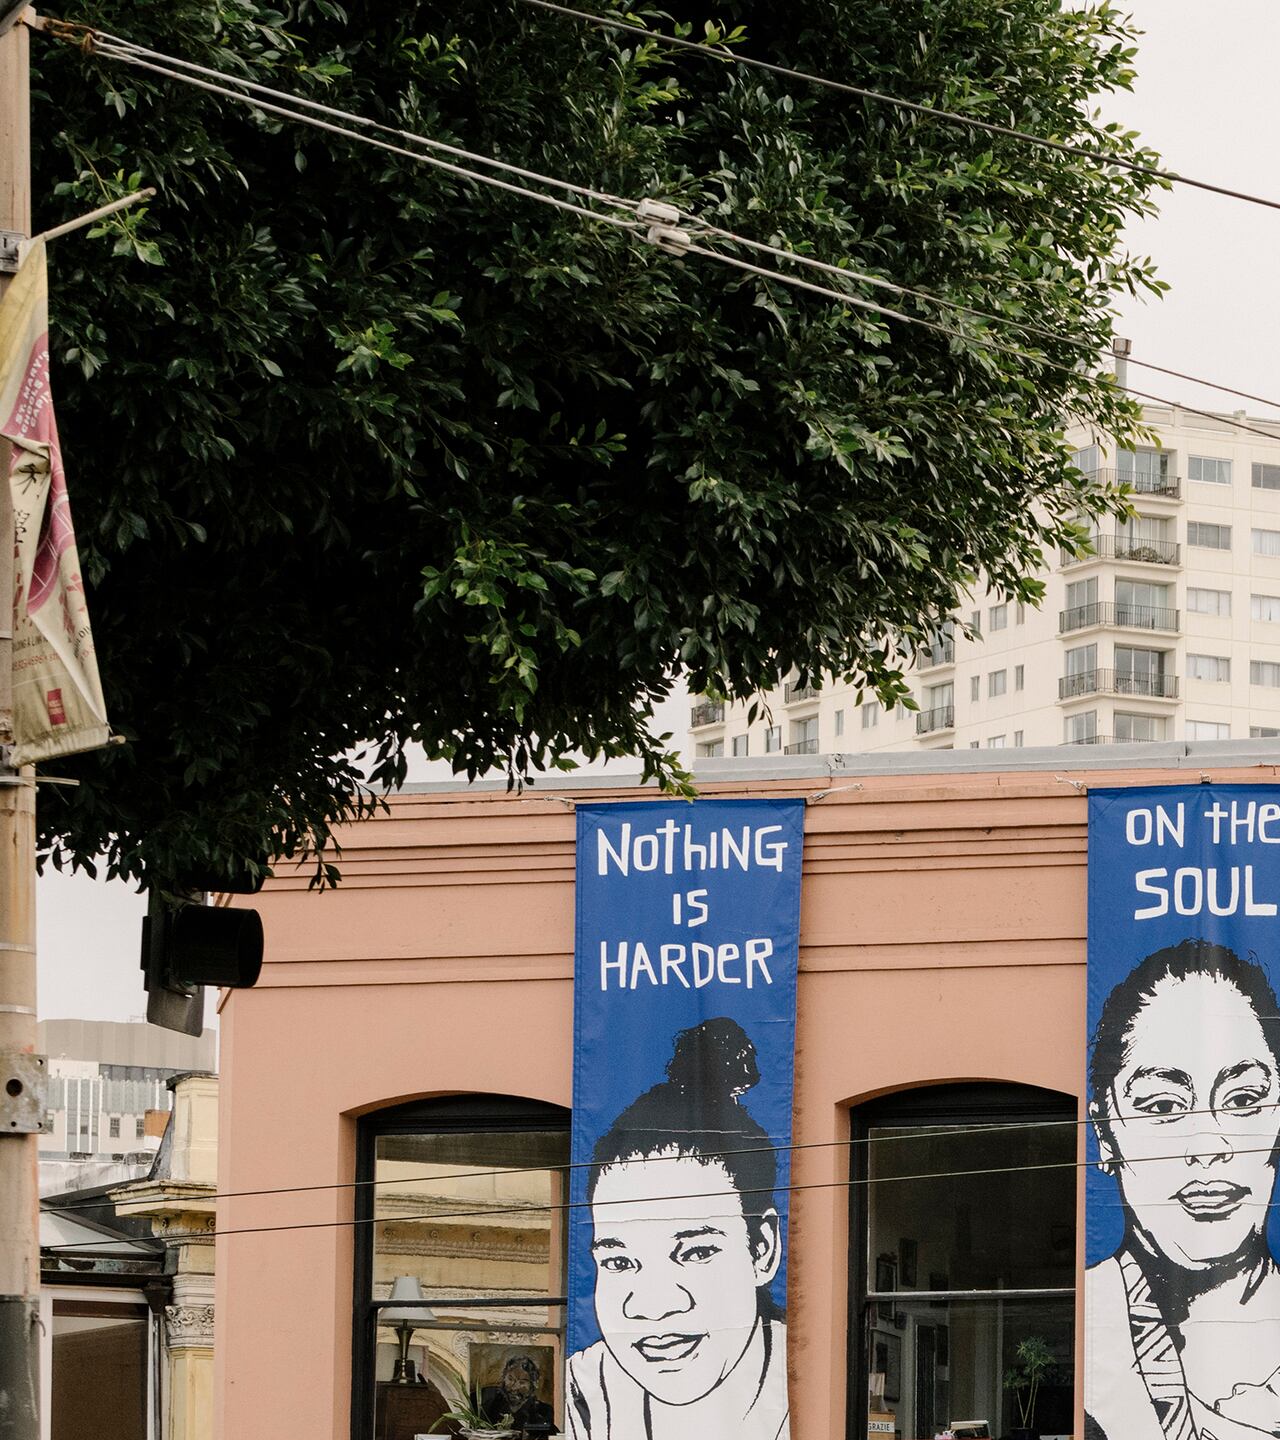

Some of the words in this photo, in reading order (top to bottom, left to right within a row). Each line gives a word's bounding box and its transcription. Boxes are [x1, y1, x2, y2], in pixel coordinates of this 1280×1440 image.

[1126, 802, 1185, 847] ON
[673, 888, 709, 927] IS
[1134, 865, 1278, 920] SOUL
